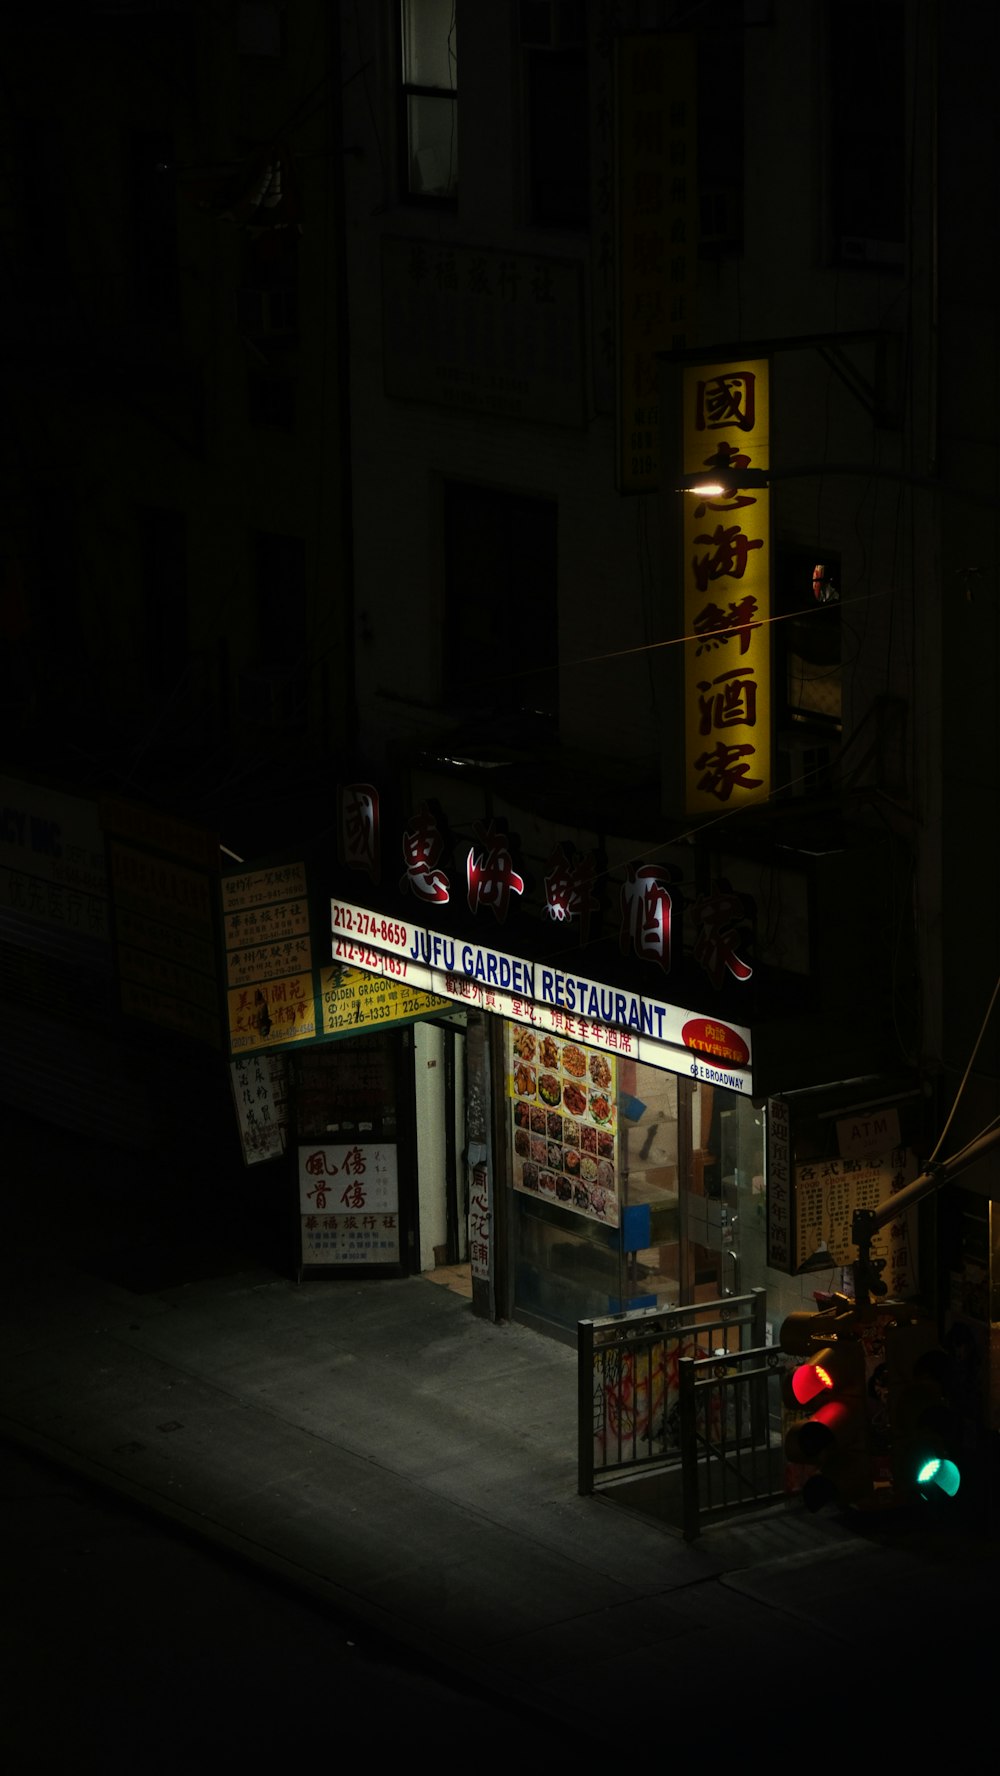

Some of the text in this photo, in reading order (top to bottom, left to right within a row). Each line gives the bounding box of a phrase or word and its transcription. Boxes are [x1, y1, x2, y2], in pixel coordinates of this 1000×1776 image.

[337, 783, 755, 991] 國惠海鮮酒家
[333, 904, 408, 947] 212-274-8659
[335, 935, 409, 978] 212-925-1637
[325, 988, 355, 1003] GOLDEN
[358, 981, 392, 997] GRAGON
[410, 930, 667, 1038] JUFU GARDEN RESTAURANT
[700, 1066, 705, 1078] E
[706, 1068, 744, 1089] BROADWAY
[851, 1119, 888, 1141] ATM
[799, 1156, 884, 1182] 各式點心
[304, 1215, 397, 1231] 華福旅行社
